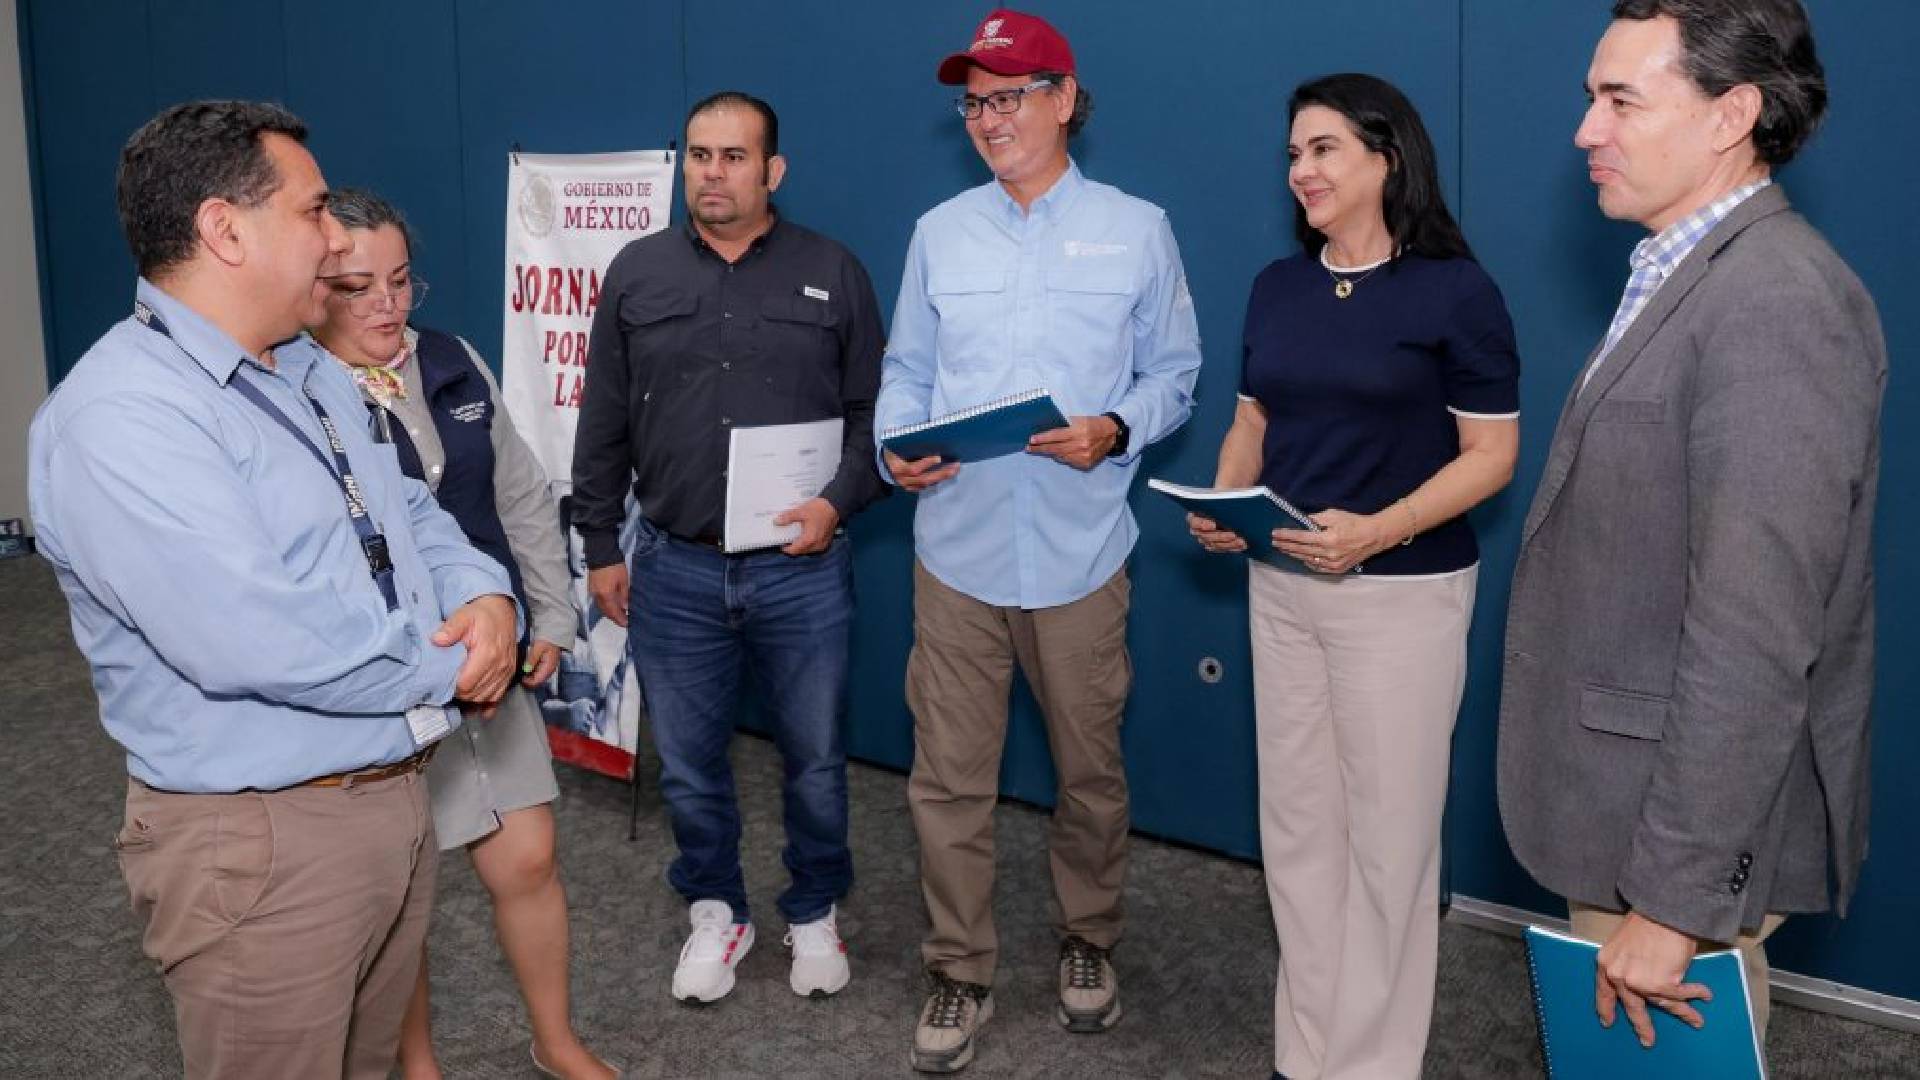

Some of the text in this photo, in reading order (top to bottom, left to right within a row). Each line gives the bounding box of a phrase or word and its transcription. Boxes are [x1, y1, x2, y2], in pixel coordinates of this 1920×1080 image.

[564, 182, 652, 197] GOBIERNO DE
[564, 199, 650, 230] MÉXICO
[543, 331, 588, 367] POR
[554, 372, 584, 408] LA
